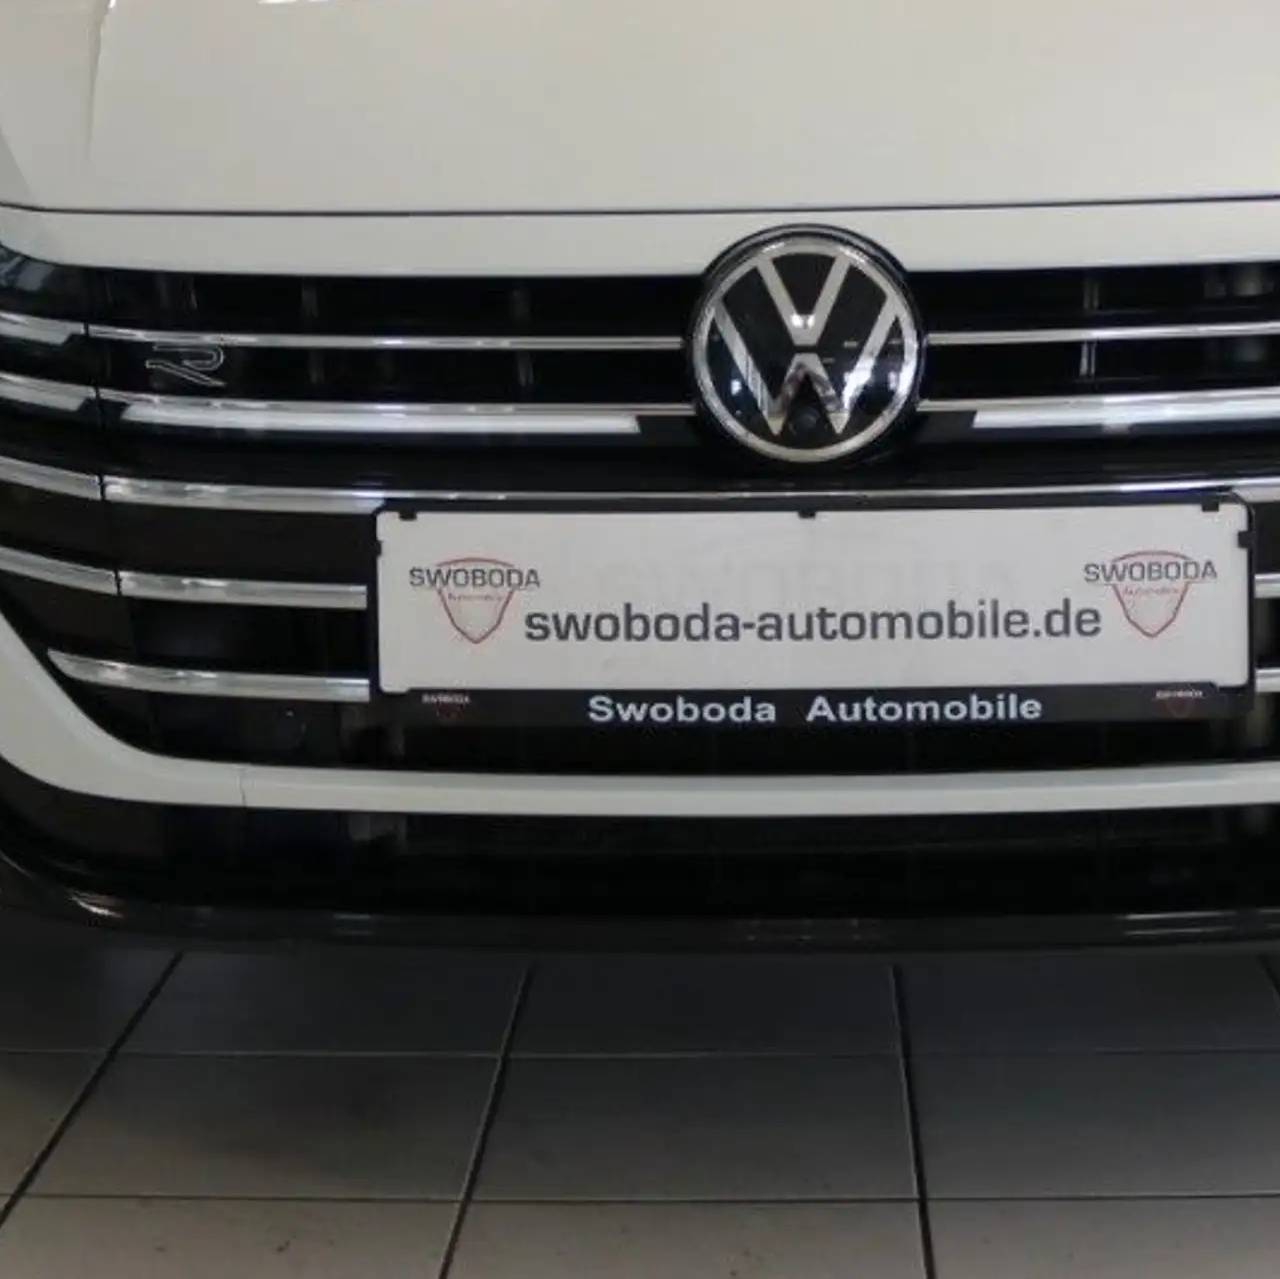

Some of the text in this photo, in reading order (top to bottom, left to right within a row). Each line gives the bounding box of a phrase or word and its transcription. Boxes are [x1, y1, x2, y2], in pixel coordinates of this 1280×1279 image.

[408, 567, 541, 589] SWOBODA
[1083, 561, 1218, 584] SWOBODA
[524, 597, 1102, 643] swoboda-automobile.de
[587, 692, 1043, 723] Swoboda Automobile
